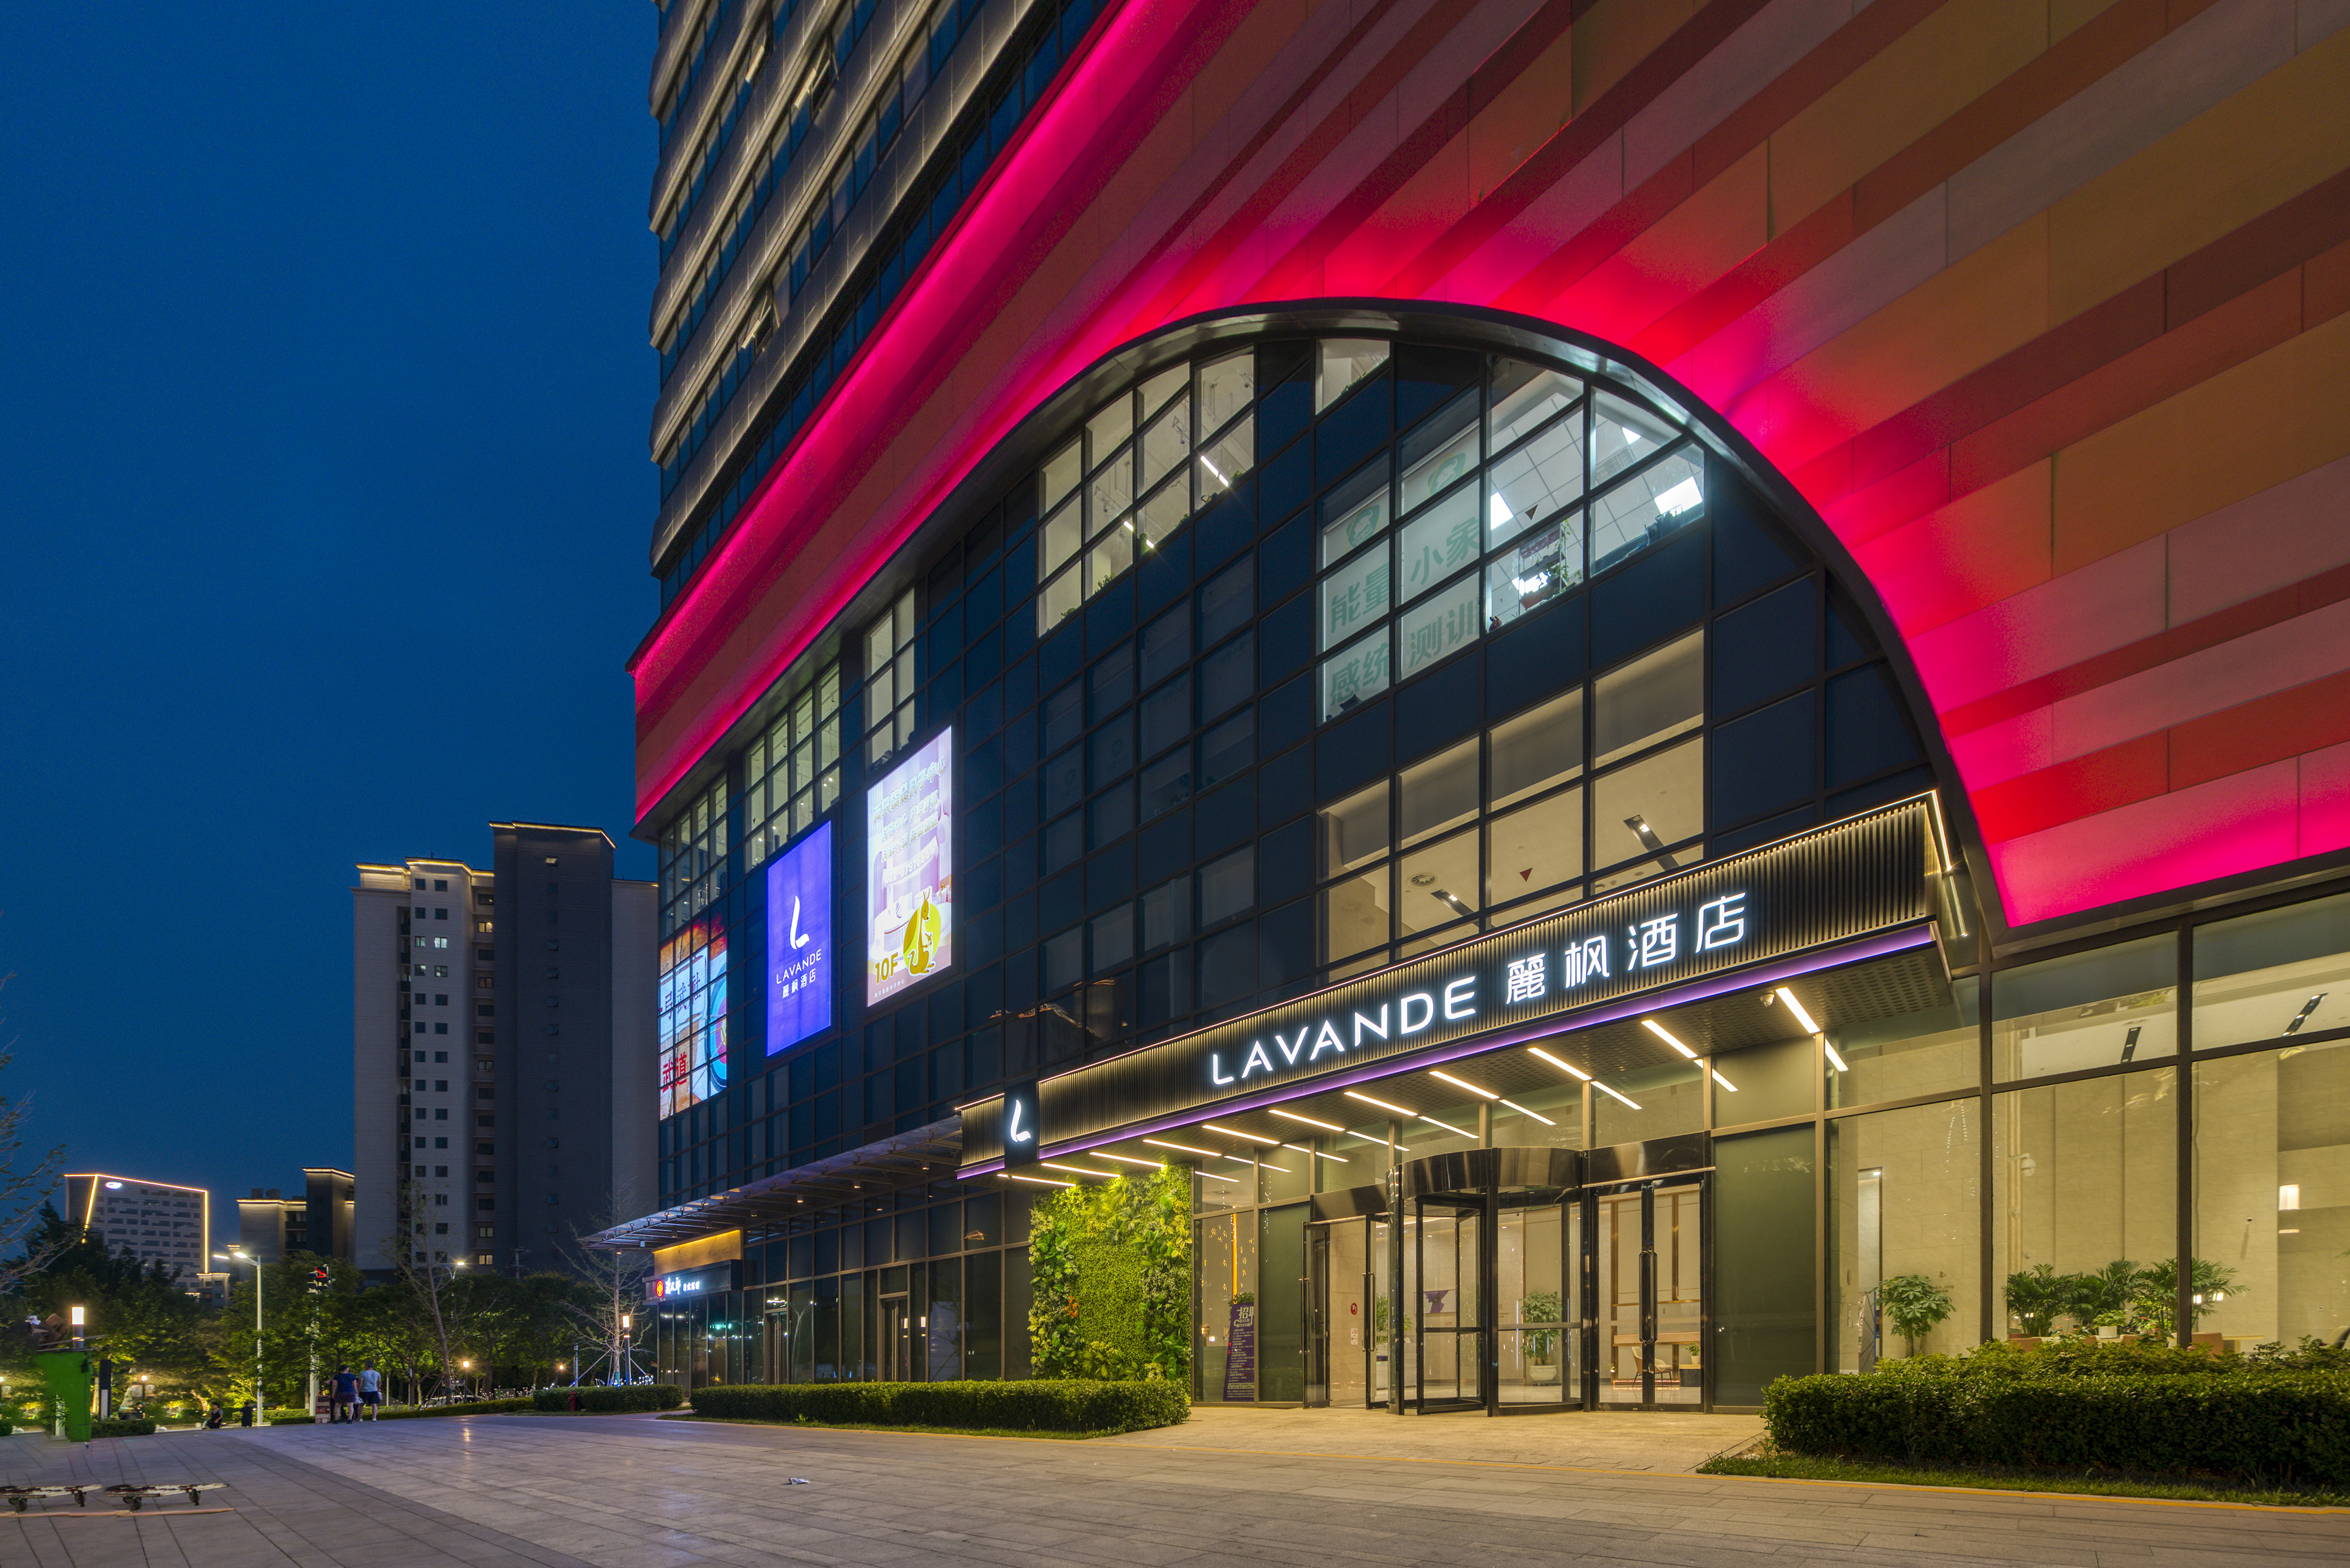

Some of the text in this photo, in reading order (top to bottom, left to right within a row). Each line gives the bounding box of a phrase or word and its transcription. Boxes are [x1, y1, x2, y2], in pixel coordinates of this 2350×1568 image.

[1331, 562, 1389, 633] 能量
[777, 949, 821, 984] LAVANDE
[783, 968, 816, 999] 麗枫酒店
[875, 952, 898, 984] 10F
[1213, 892, 1746, 1085] LAVANDE 麗枫酒店
[662, 1051, 687, 1093] 武道
